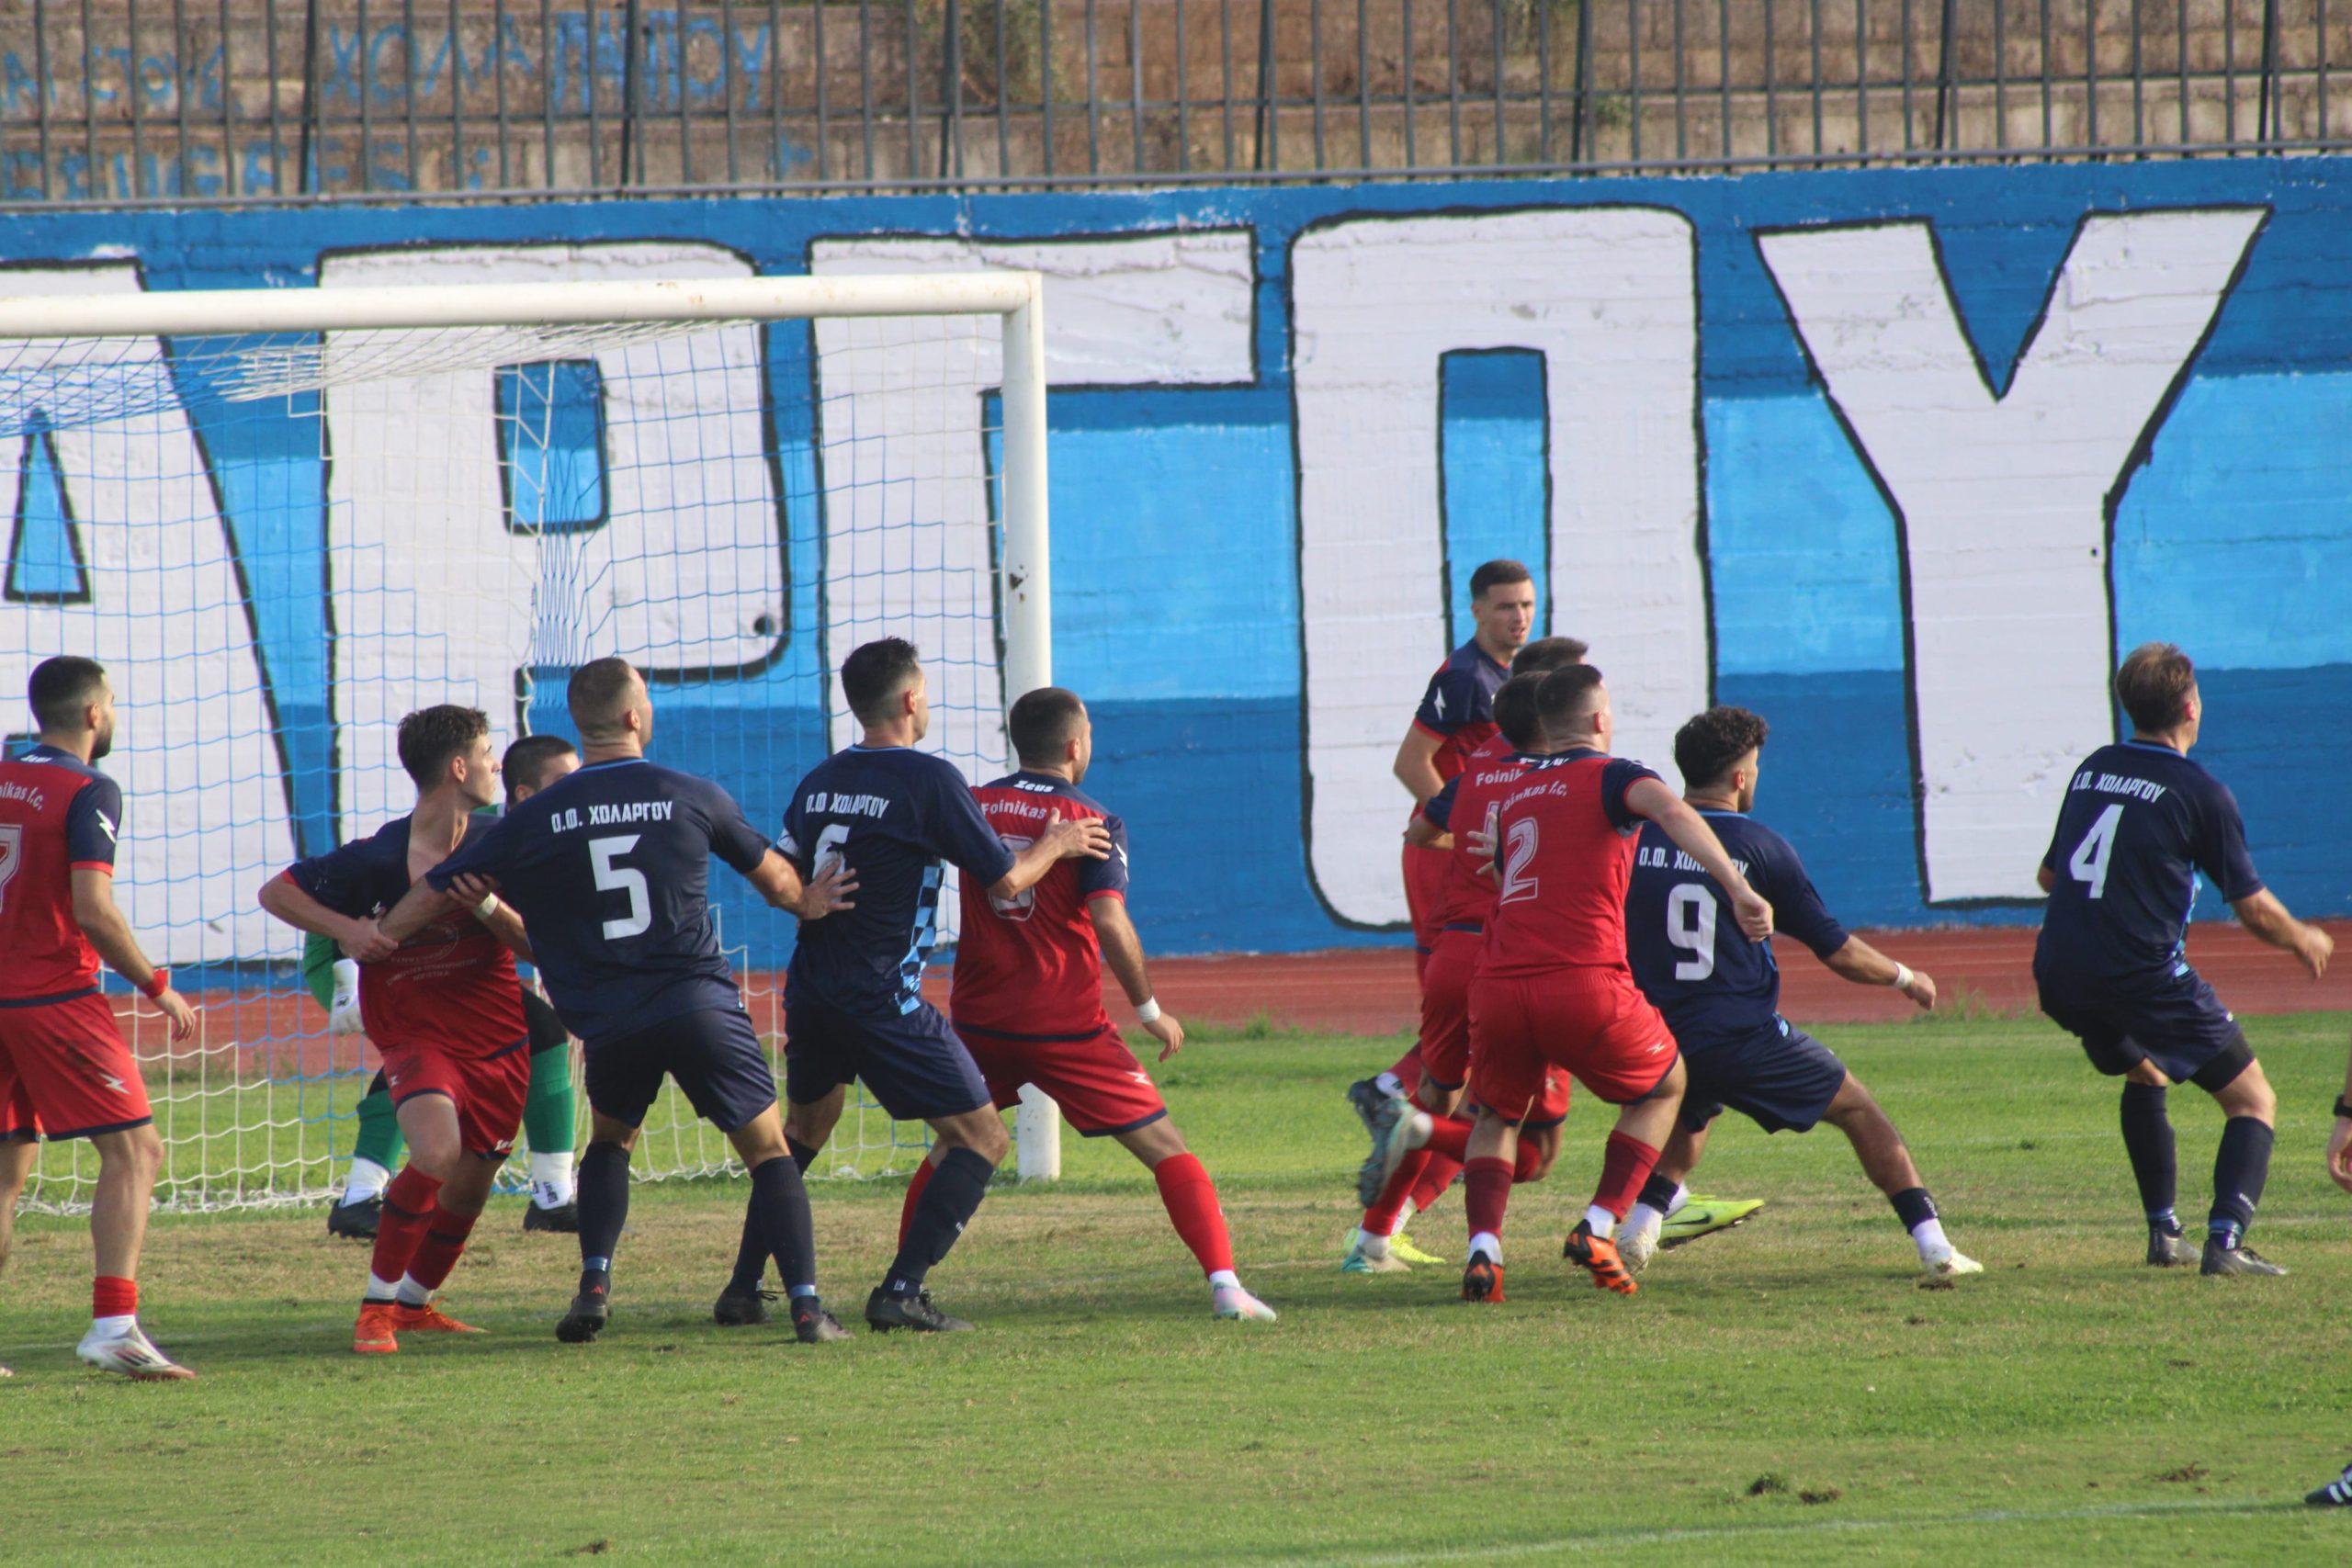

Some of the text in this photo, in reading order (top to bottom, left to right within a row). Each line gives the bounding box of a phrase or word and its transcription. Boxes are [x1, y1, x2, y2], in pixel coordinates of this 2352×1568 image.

[588, 800, 673, 825] ΧΟΛΑΡΓΟΥ
[980, 798, 1047, 819] Foinikas
[1013, 780, 1055, 793] Zeus
[2094, 773, 2167, 804] ΧΟΛΑΡΓΟΥ
[1499, 817, 1539, 905] 2
[2069, 803, 2125, 899] 4
[588, 834, 652, 940] 5
[1667, 883, 1717, 981] 9
